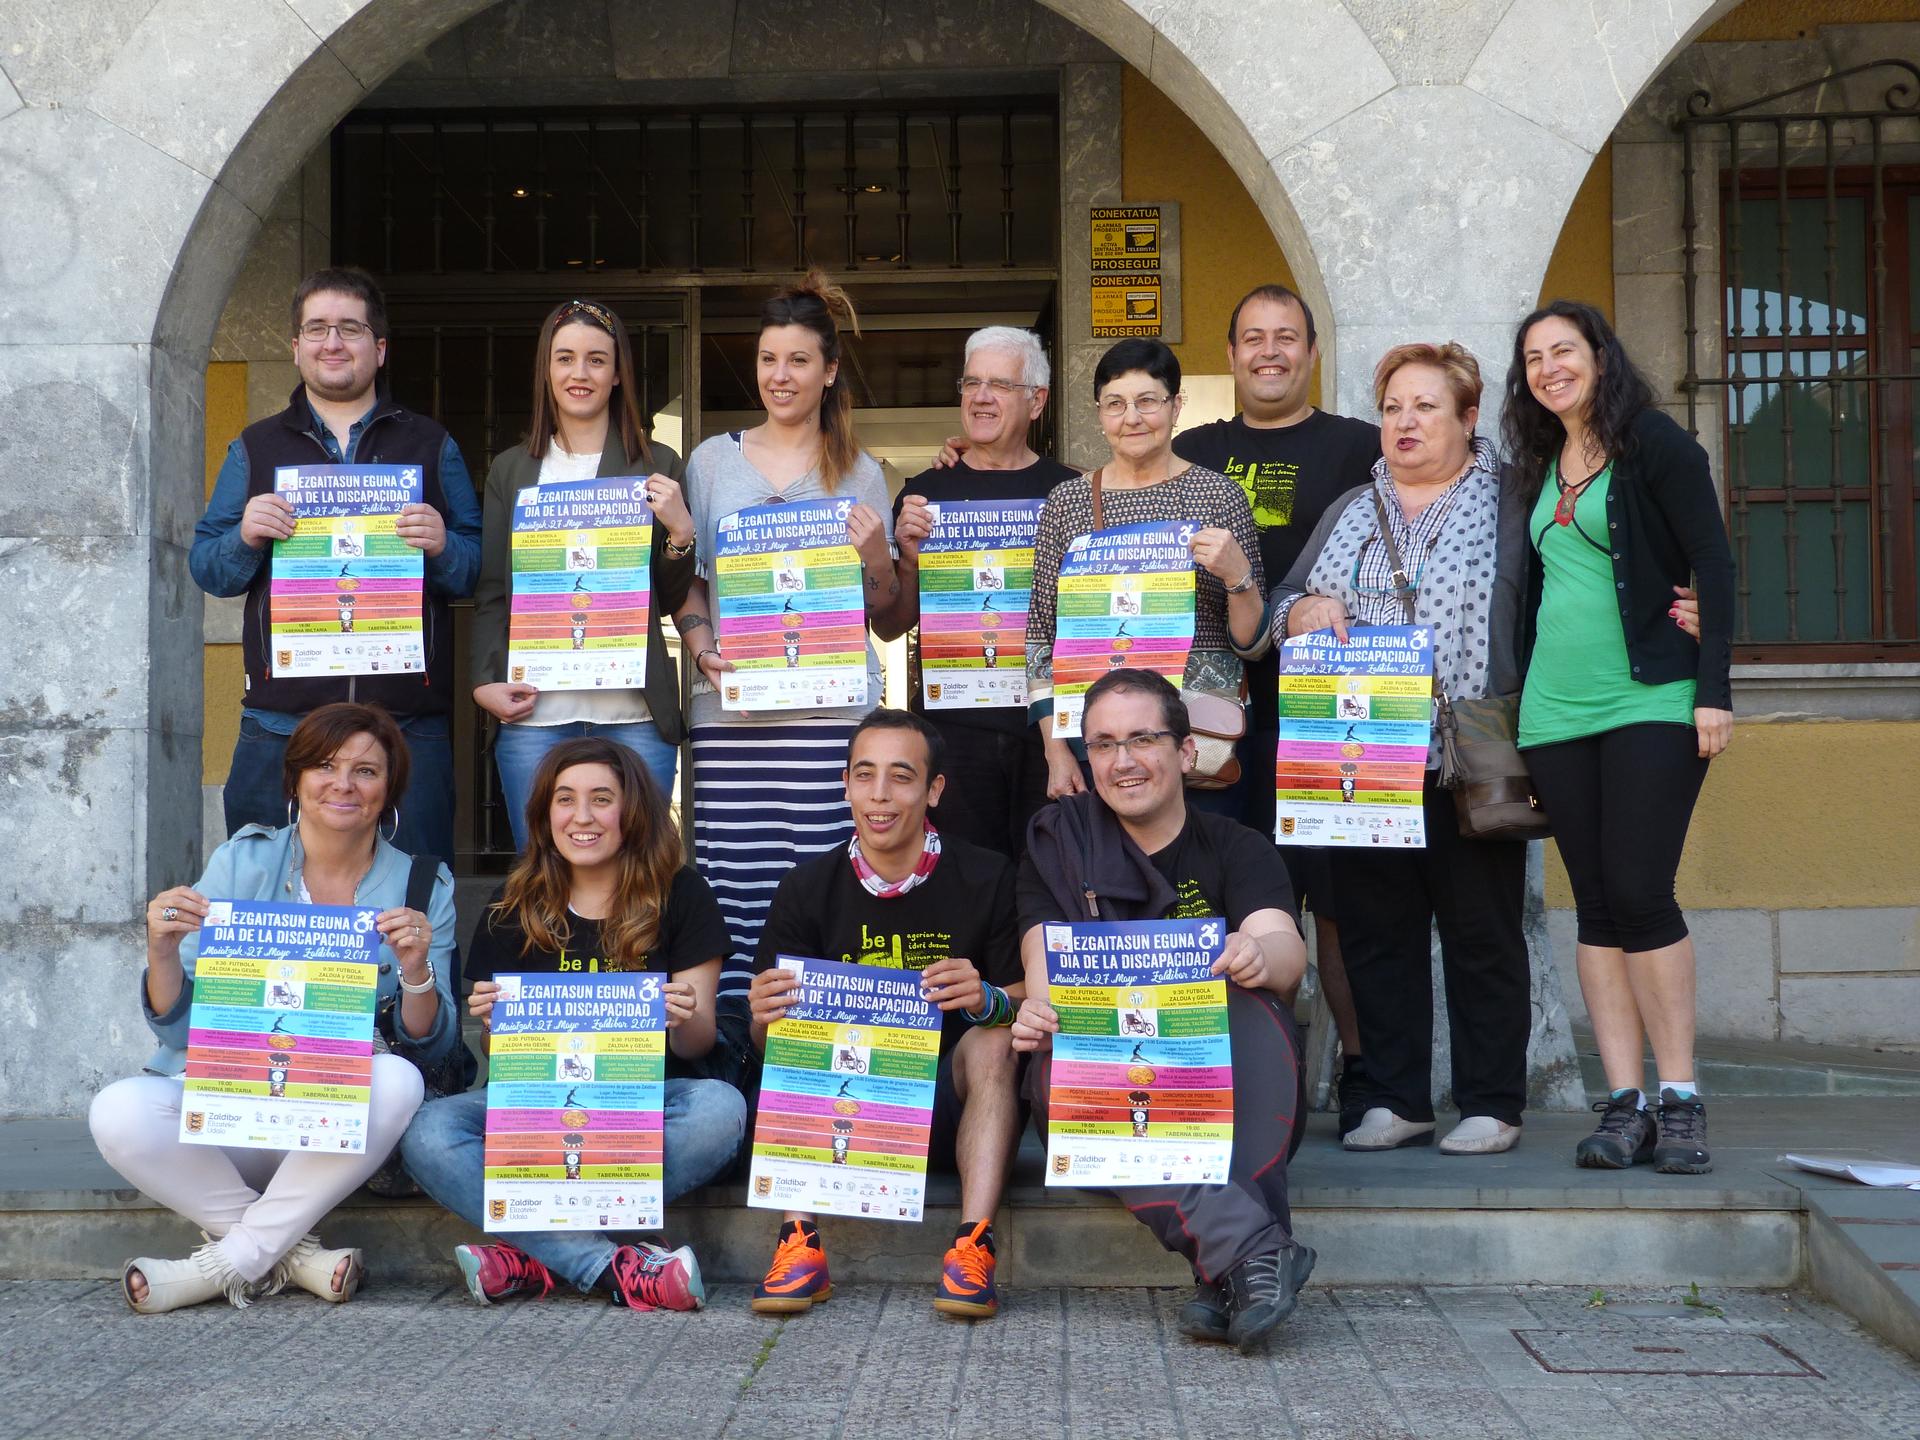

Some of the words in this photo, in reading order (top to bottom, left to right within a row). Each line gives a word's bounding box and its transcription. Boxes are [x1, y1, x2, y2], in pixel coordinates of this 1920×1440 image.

[1091, 209, 1159, 219] KONEKTATUA
[1092, 260, 1159, 269] PROSEGUR
[1092, 276, 1159, 286] CONECTADA
[1093, 327, 1160, 336] PROSEGUR
[1223, 457, 1244, 473] be
[298, 475, 361, 489] EZGAITASUN
[363, 475, 398, 488] EGUNA
[286, 491, 303, 503] DIA
[306, 492, 319, 503] DE
[322, 492, 334, 503] LA
[337, 490, 410, 502] DISCAPACIDAD
[538, 490, 595, 503] EZGAITASUN
[598, 488, 629, 501] EGUNA
[328, 507, 350, 516] Mayo
[360, 503, 391, 514] Zaldibar
[525, 506, 540, 517] DIA
[543, 505, 555, 517] DE
[558, 504, 570, 516] LA
[572, 502, 641, 516] DISCAPACIDAD
[941, 511, 999, 524] EZGAITASUN
[1002, 509, 1034, 522] EGUNA
[563, 519, 584, 529] Mayo
[593, 516, 623, 527] Zaldibar
[625, 515, 647, 525] 2017
[739, 511, 798, 528] EZGAITASUN
[801, 509, 833, 521] EGUNA
[727, 531, 743, 542] DIA
[746, 529, 758, 540] DE
[762, 528, 773, 539] LA
[776, 522, 846, 538] DISCAPACIDAD
[930, 526, 946, 538] DIA
[948, 526, 961, 538] DE
[963, 526, 975, 537] LA
[978, 524, 1038, 537] DISCAPACIDA
[768, 542, 789, 552] Mayo
[800, 536, 829, 548] Zaldibar
[969, 540, 990, 550] Mayo
[1000, 537, 1028, 548] Zaldibar
[1086, 533, 1140, 549] EZGAITASUN
[1143, 532, 1175, 545] EGUNA
[1073, 551, 1087, 563] DIA
[1090, 550, 1102, 561] DE
[1104, 550, 1115, 561] LA
[1118, 547, 1187, 561] DISCAPACIDAD
[1109, 563, 1129, 574] Mayo
[1139, 560, 1169, 571] Zaldibar
[1171, 560, 1193, 570] 2017
[1307, 634, 1369, 648] EZGAISUN
[1372, 636, 1407, 648] EGUNA
[1292, 648, 1309, 660] DIA
[1312, 649, 1326, 661] DE
[1328, 650, 1341, 662] LA
[1344, 650, 1420, 663] DISCAPACIDAD
[1333, 664, 1356, 676] Mayo
[1366, 663, 1398, 673] Zaldibar
[1401, 664, 1425, 673] 2017
[232, 911, 307, 929] EZGAITASUN
[310, 915, 350, 930] EGUNA
[215, 928, 235, 941] DIA
[240, 929, 255, 942] DE
[258, 930, 273, 944] LA
[276, 931, 364, 949] DISCAPACIDAD
[862, 925, 885, 949] be
[1074, 935, 1150, 951] EZGAITASUN
[1154, 933, 1196, 950] EGUNA
[263, 947, 291, 961] Mayo
[303, 946, 340, 960] Zaldibar
[344, 949, 371, 961] 2017
[559, 947, 582, 971] be
[1060, 954, 1081, 969] DIA
[1084, 954, 1100, 969] DE
[1103, 955, 1119, 969] LA
[1122, 952, 1211, 969] DISCAPACIDAD
[803, 971, 874, 994] EZGAITASUN
[877, 979, 916, 999] EGUNA
[1111, 974, 1138, 987] Mayo
[1151, 968, 1188, 982] Zaldibar
[1191, 968, 1213, 979] 201
[522, 985, 594, 1000] EZGAITASUN
[597, 985, 637, 1000] EGUNA
[506, 1003, 525, 1017] DIA
[529, 1003, 545, 1016] DE
[549, 1003, 562, 1017] LA
[565, 1002, 650, 1017] DISCAPACIDAD
[809, 989, 824, 1005] DE
[828, 991, 841, 1007] LA
[845, 993, 929, 1016] DISCAPACIDAD
[554, 1020, 579, 1033] Mayo
[591, 1017, 628, 1030] Zaldibar
[631, 1018, 657, 1029] 2017
[832, 1011, 858, 1024] Mayo
[870, 1010, 906, 1026] Zaldibar
[909, 1014, 935, 1027] 2017
[209, 1113, 242, 1122] Zaldibar
[1074, 1154, 1106, 1163] Zaldibar
[776, 1177, 807, 1187] Zaldibar
[510, 1198, 542, 1207] Zaldibar
